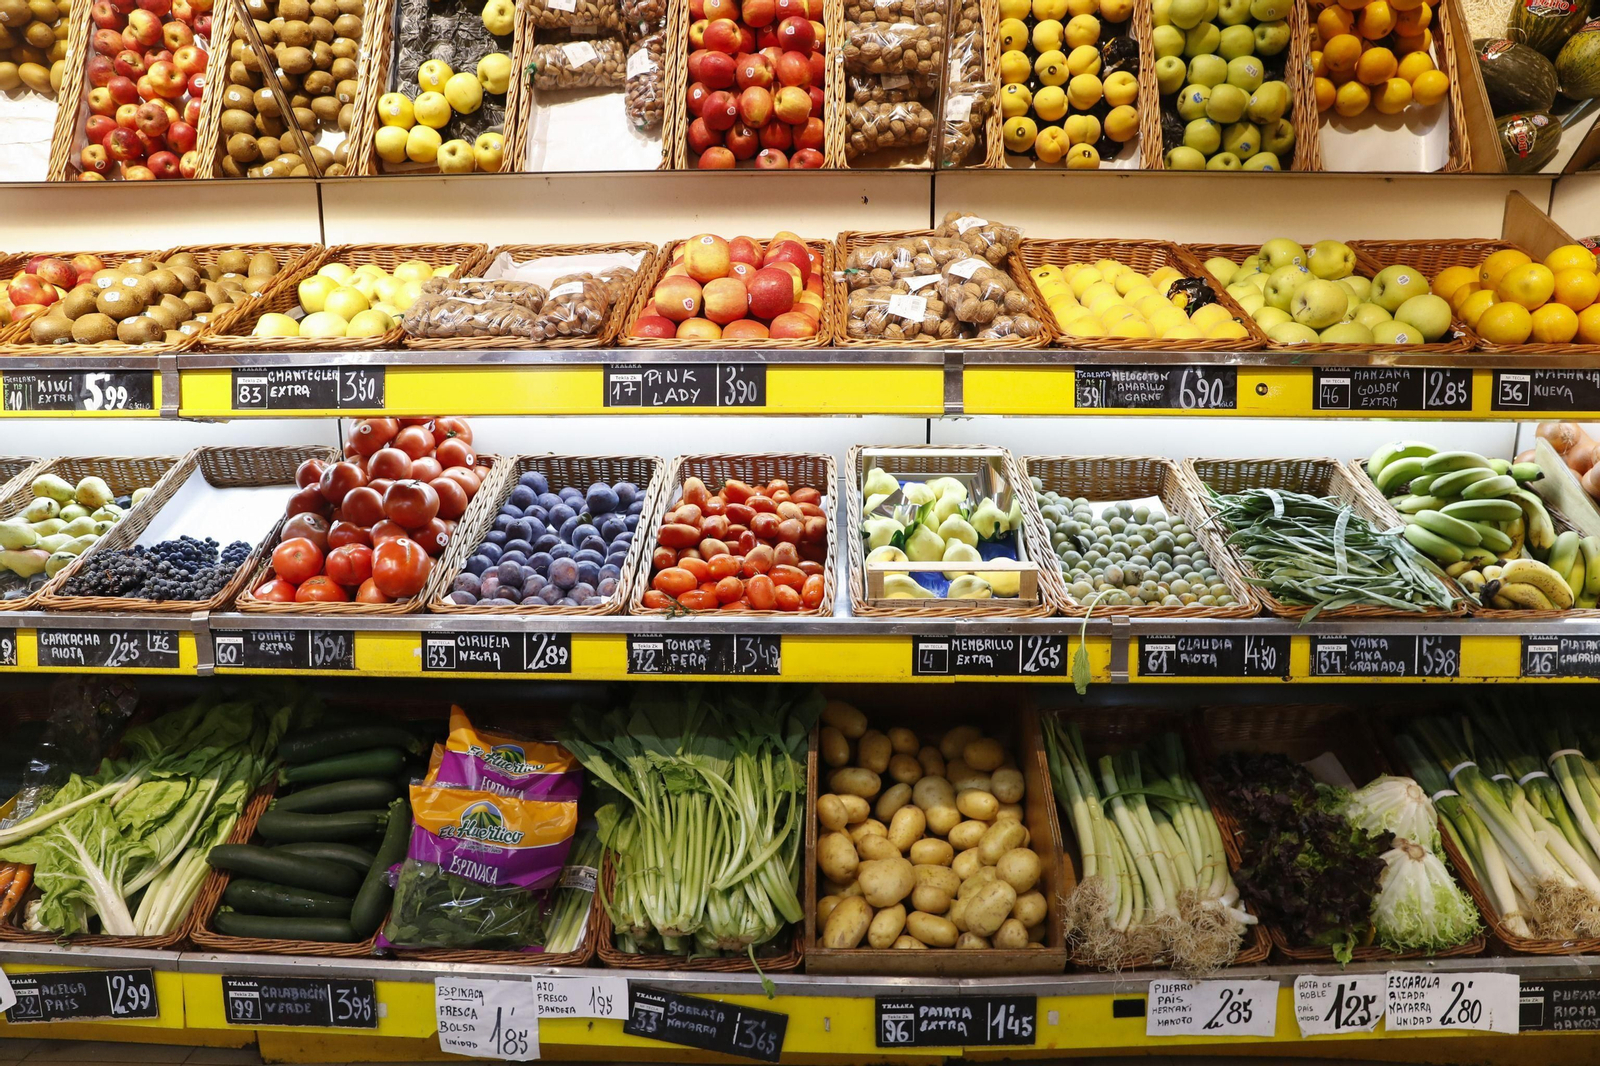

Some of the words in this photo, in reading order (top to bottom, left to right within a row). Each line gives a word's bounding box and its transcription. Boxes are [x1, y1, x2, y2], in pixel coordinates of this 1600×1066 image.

[1354, 369, 1410, 381] MANZANA
[239, 386, 262, 403] 83
[270, 385, 310, 398] EXTRA
[612, 382, 637, 400] 17
[1322, 386, 1339, 404] 46
[1358, 381, 1400, 395] GOLDEN
[1502, 383, 1523, 401] 36
[9, 391, 22, 410] 10
[38, 394, 74, 404] EXTRA
[653, 388, 701, 405] LADY
[1081, 387, 1099, 407] 39
[1361, 397, 1398, 408] EXTRA
[153, 635, 169, 650] 76
[250, 631, 296, 642] TOMATE
[259, 642, 293, 651] EXTRA
[665, 639, 711, 651] TOMATE
[952, 638, 1014, 652] MEMBRILLO
[1561, 639, 1600, 651] PLATAN
[51, 647, 85, 665] RIOJA
[218, 643, 237, 663] 60
[429, 645, 447, 667] 55
[459, 650, 501, 670] NEGRA
[670, 653, 707, 667] PERA
[633, 650, 658, 671] 72
[956, 655, 994, 668] EXTRA
[1147, 651, 1168, 673] 61
[1320, 651, 1341, 673] 54
[1530, 653, 1553, 673] 16
[456, 819, 525, 844] Huertico
[448, 855, 498, 884] ESPINACA
[536, 981, 554, 992] AJO
[1154, 983, 1193, 994] PUERRO
[1322, 981, 1332, 989] DE
[1388, 975, 1440, 990] ESCAROLA
[537, 993, 568, 1003] FRESCO
[636, 992, 666, 1002] TXALAKA
[1300, 990, 1327, 1000] ROBLE
[234, 999, 254, 1018] 99
[265, 1002, 312, 1014] VERDE
[439, 1006, 478, 1020] FRESCA
[919, 1006, 972, 1020] PATATA
[1388, 1002, 1432, 1015] NAVARRA
[1554, 1005, 1596, 1017] RIOJA
[438, 1020, 476, 1033] BOLSA
[635, 1010, 657, 1031] 33
[1396, 1016, 1433, 1026] UNIDAD
[666, 1018, 717, 1038] NAVARRA
[885, 1020, 909, 1042] 96
[919, 1020, 968, 1037] EXTRA
